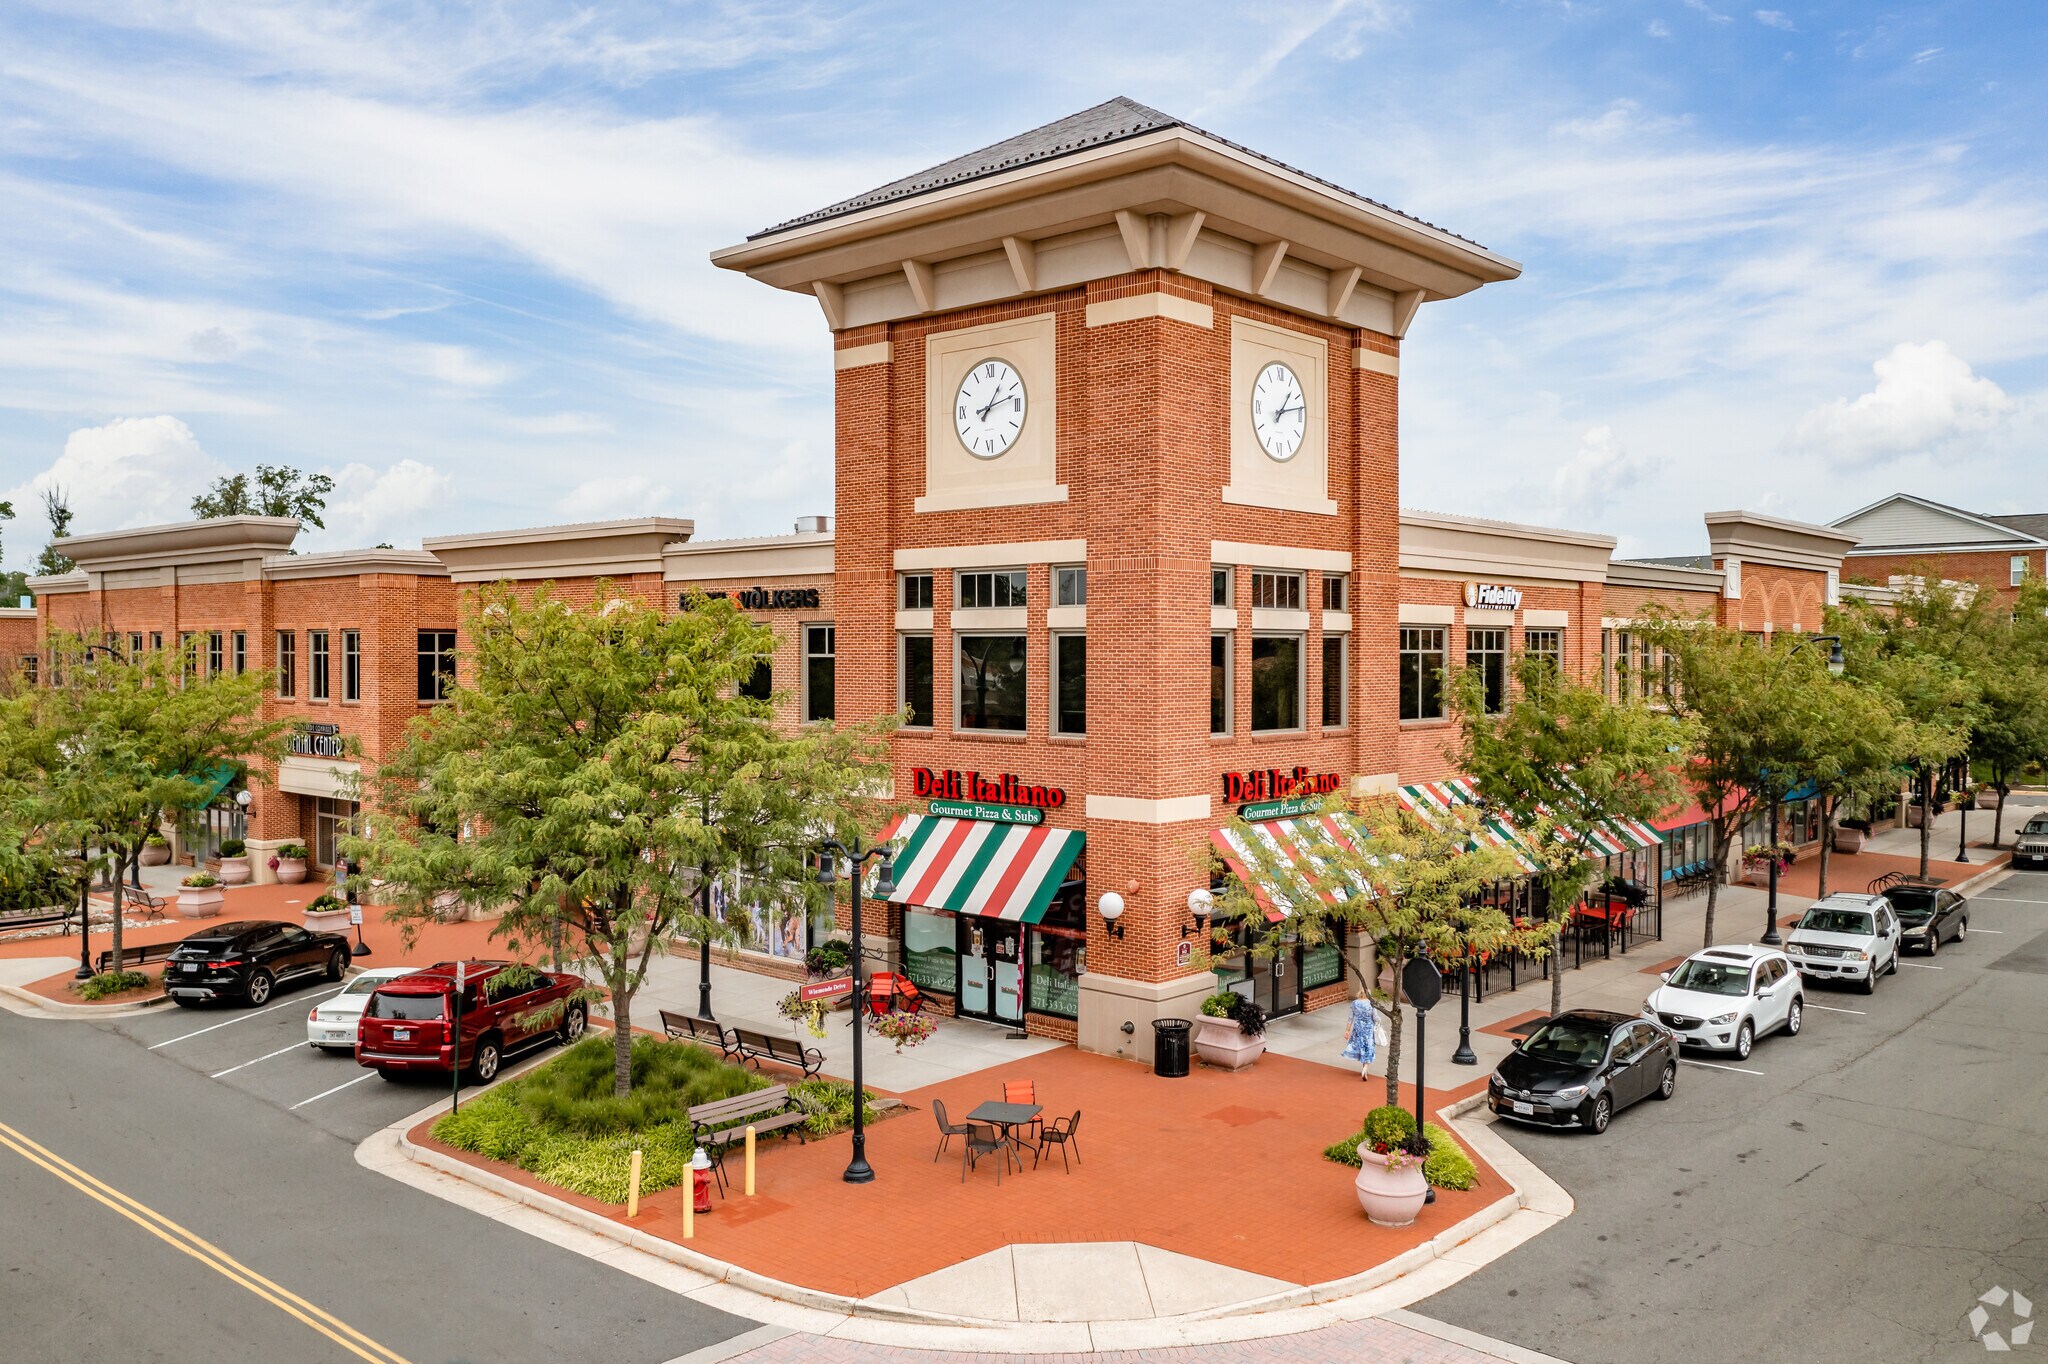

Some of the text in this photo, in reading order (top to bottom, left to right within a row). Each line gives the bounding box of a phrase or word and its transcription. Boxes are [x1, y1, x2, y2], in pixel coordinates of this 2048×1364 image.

[985, 364, 995, 378] XII
[1276, 367, 1284, 381] XII
[959, 406, 967, 419] IX
[1256, 400, 1262, 414] IX
[985, 440, 994, 453] VI
[1478, 584, 1523, 609] Fidelity
[314, 735, 344, 758] CENTER
[911, 767, 1065, 807] Deli Italiano
[1225, 767, 1340, 802] Deli Italiano
[930, 803, 1039, 822] Gourmet Pizza & Subs
[1244, 801, 1324, 819] Gourmet Pizza & Sub
[908, 973, 956, 989] 571-333-0222
[1036, 975, 1078, 991] Deli Italian
[1031, 997, 1077, 1013] 571-333-02
